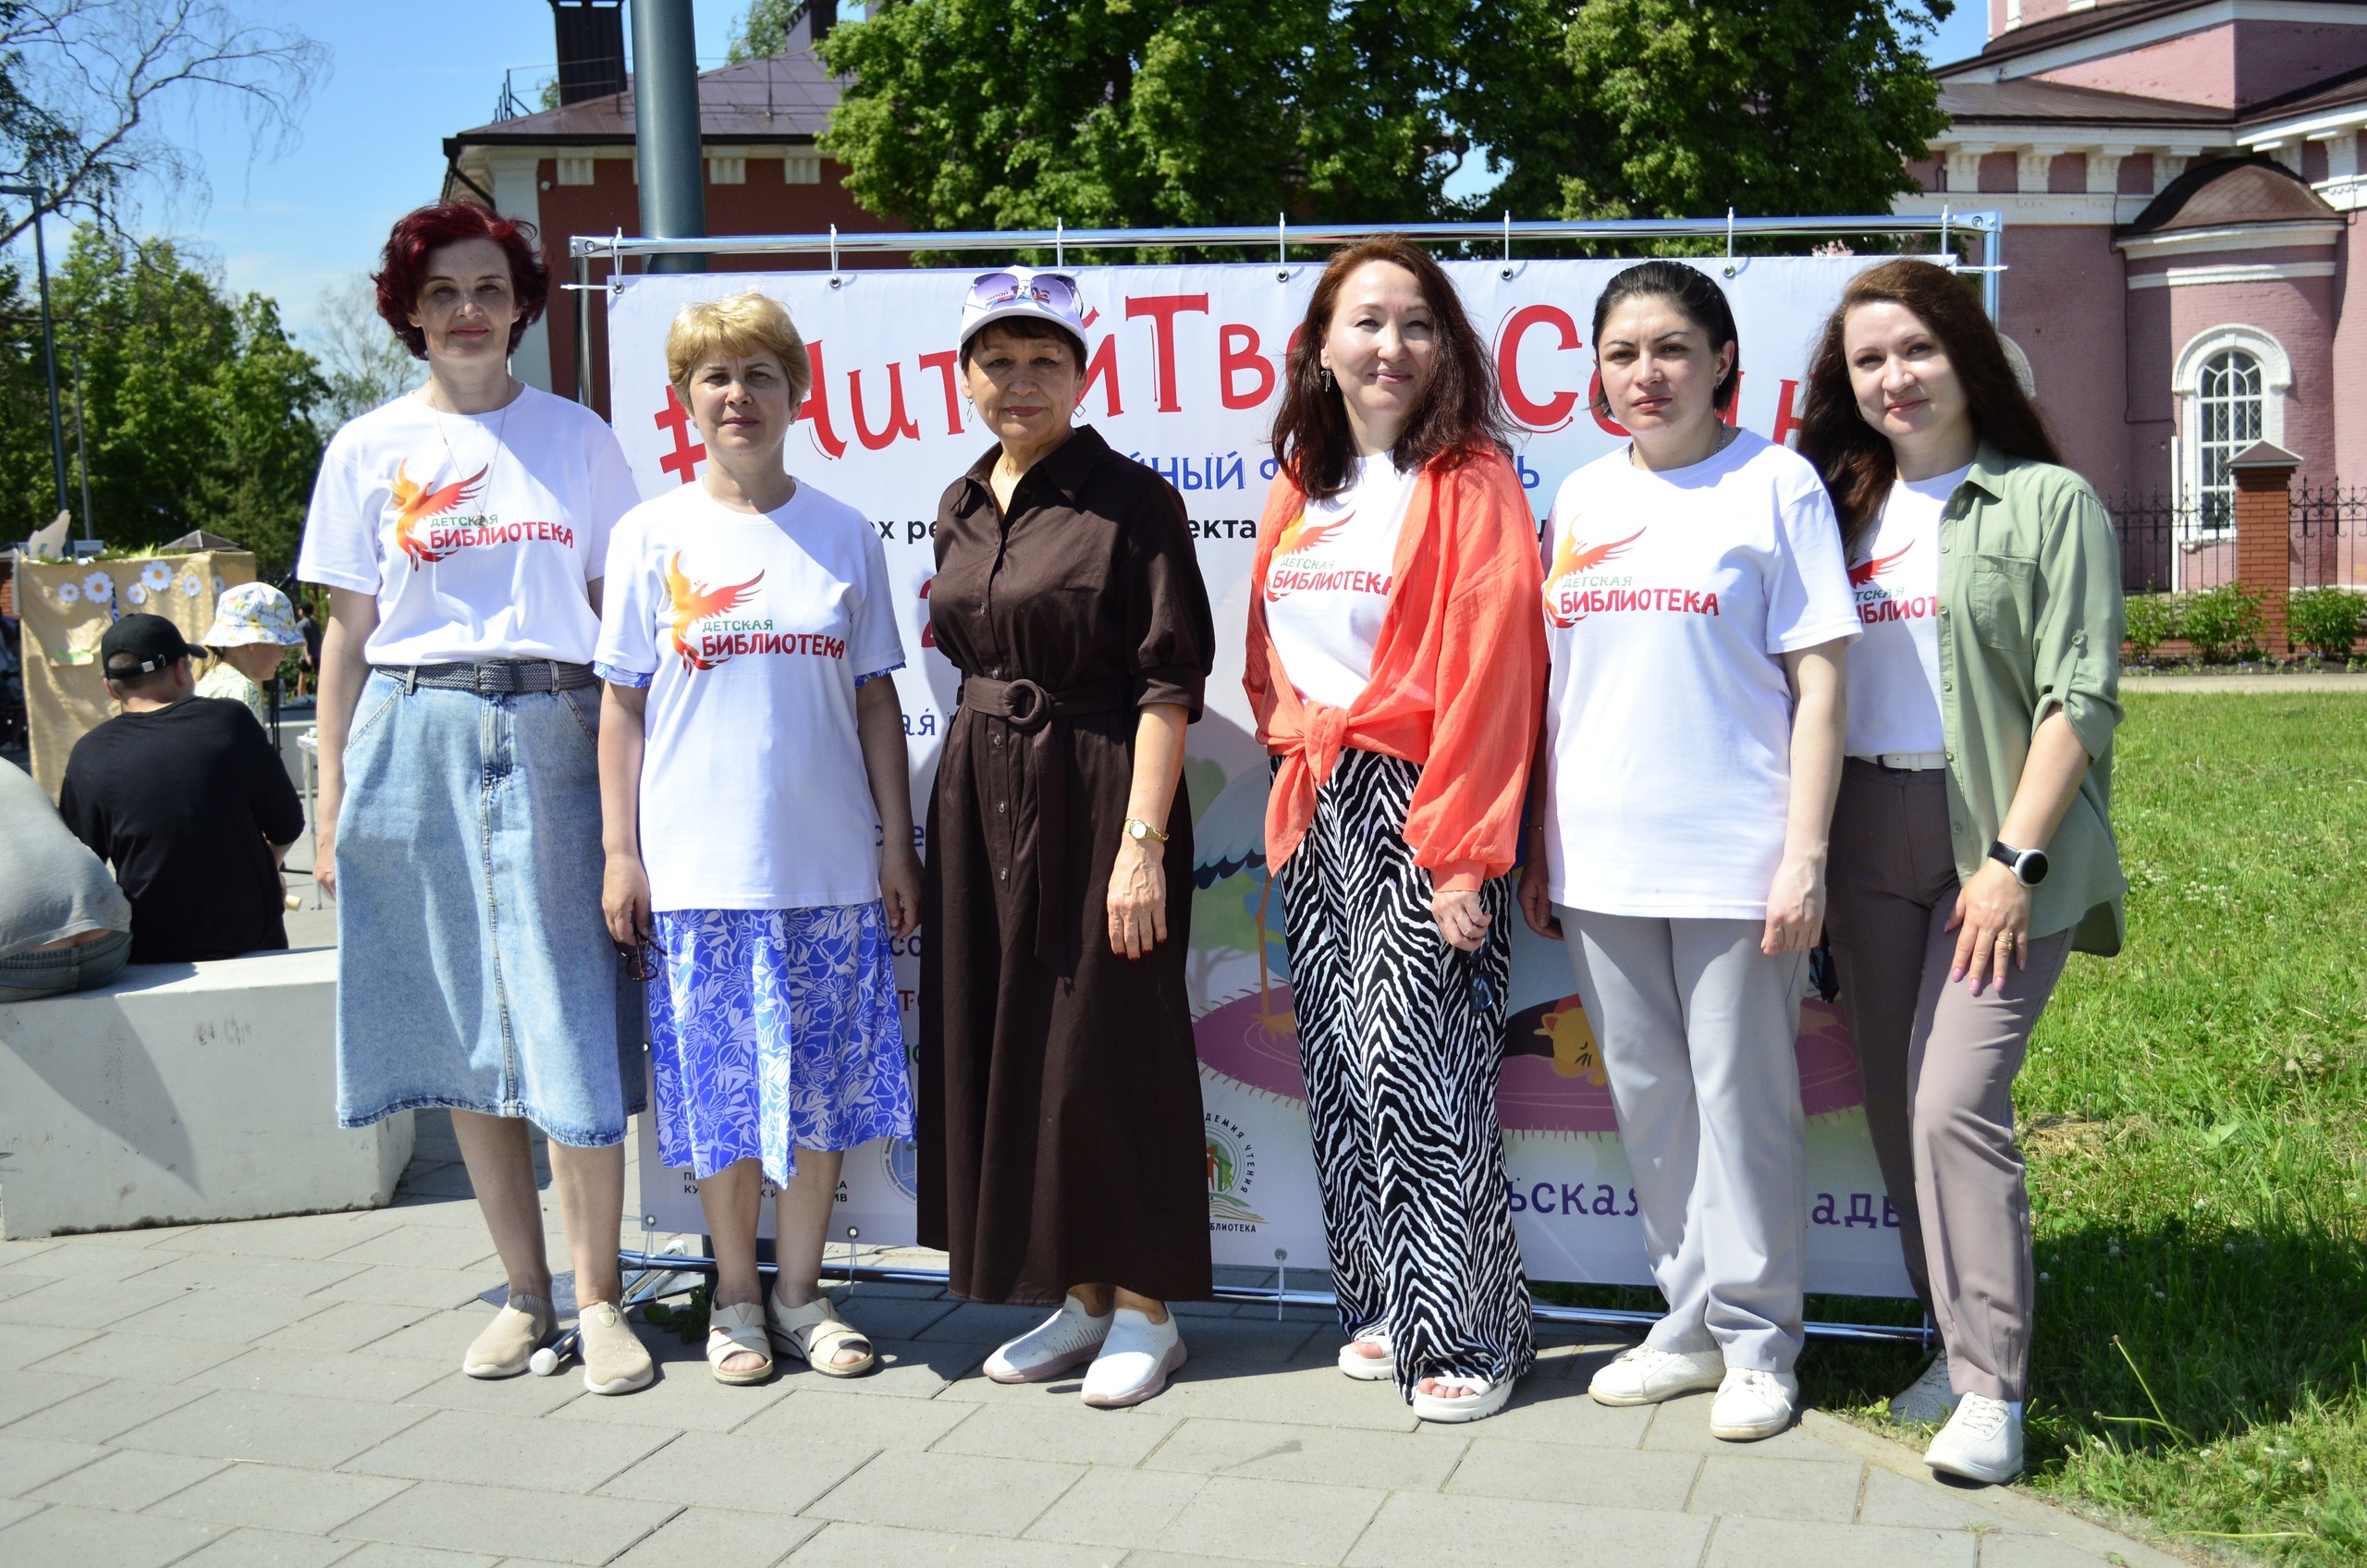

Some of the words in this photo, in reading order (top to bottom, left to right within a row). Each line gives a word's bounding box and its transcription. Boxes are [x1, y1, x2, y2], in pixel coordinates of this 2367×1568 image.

[430, 514, 498, 528] ДЕТСКЯ
[430, 521, 574, 549] БИБЛИОТЕКА
[1280, 557, 1336, 570] ДЕТСКАЯ
[1562, 576, 1633, 590] ДЕТСКАЯ
[1853, 586, 1905, 602] ТСКАЯ
[1560, 588, 1720, 617] БИБЛИОТЕКА
[702, 619, 774, 633] ДЕТСКАЯ
[702, 632, 845, 660] БИБЛИОТЕКА
[1205, 1112, 1245, 1139] ДЕМИЯ
[1240, 1144, 1256, 1194] ЧТЕНИЯ
[1209, 1221, 1257, 1233] БЛИОТЕКА
